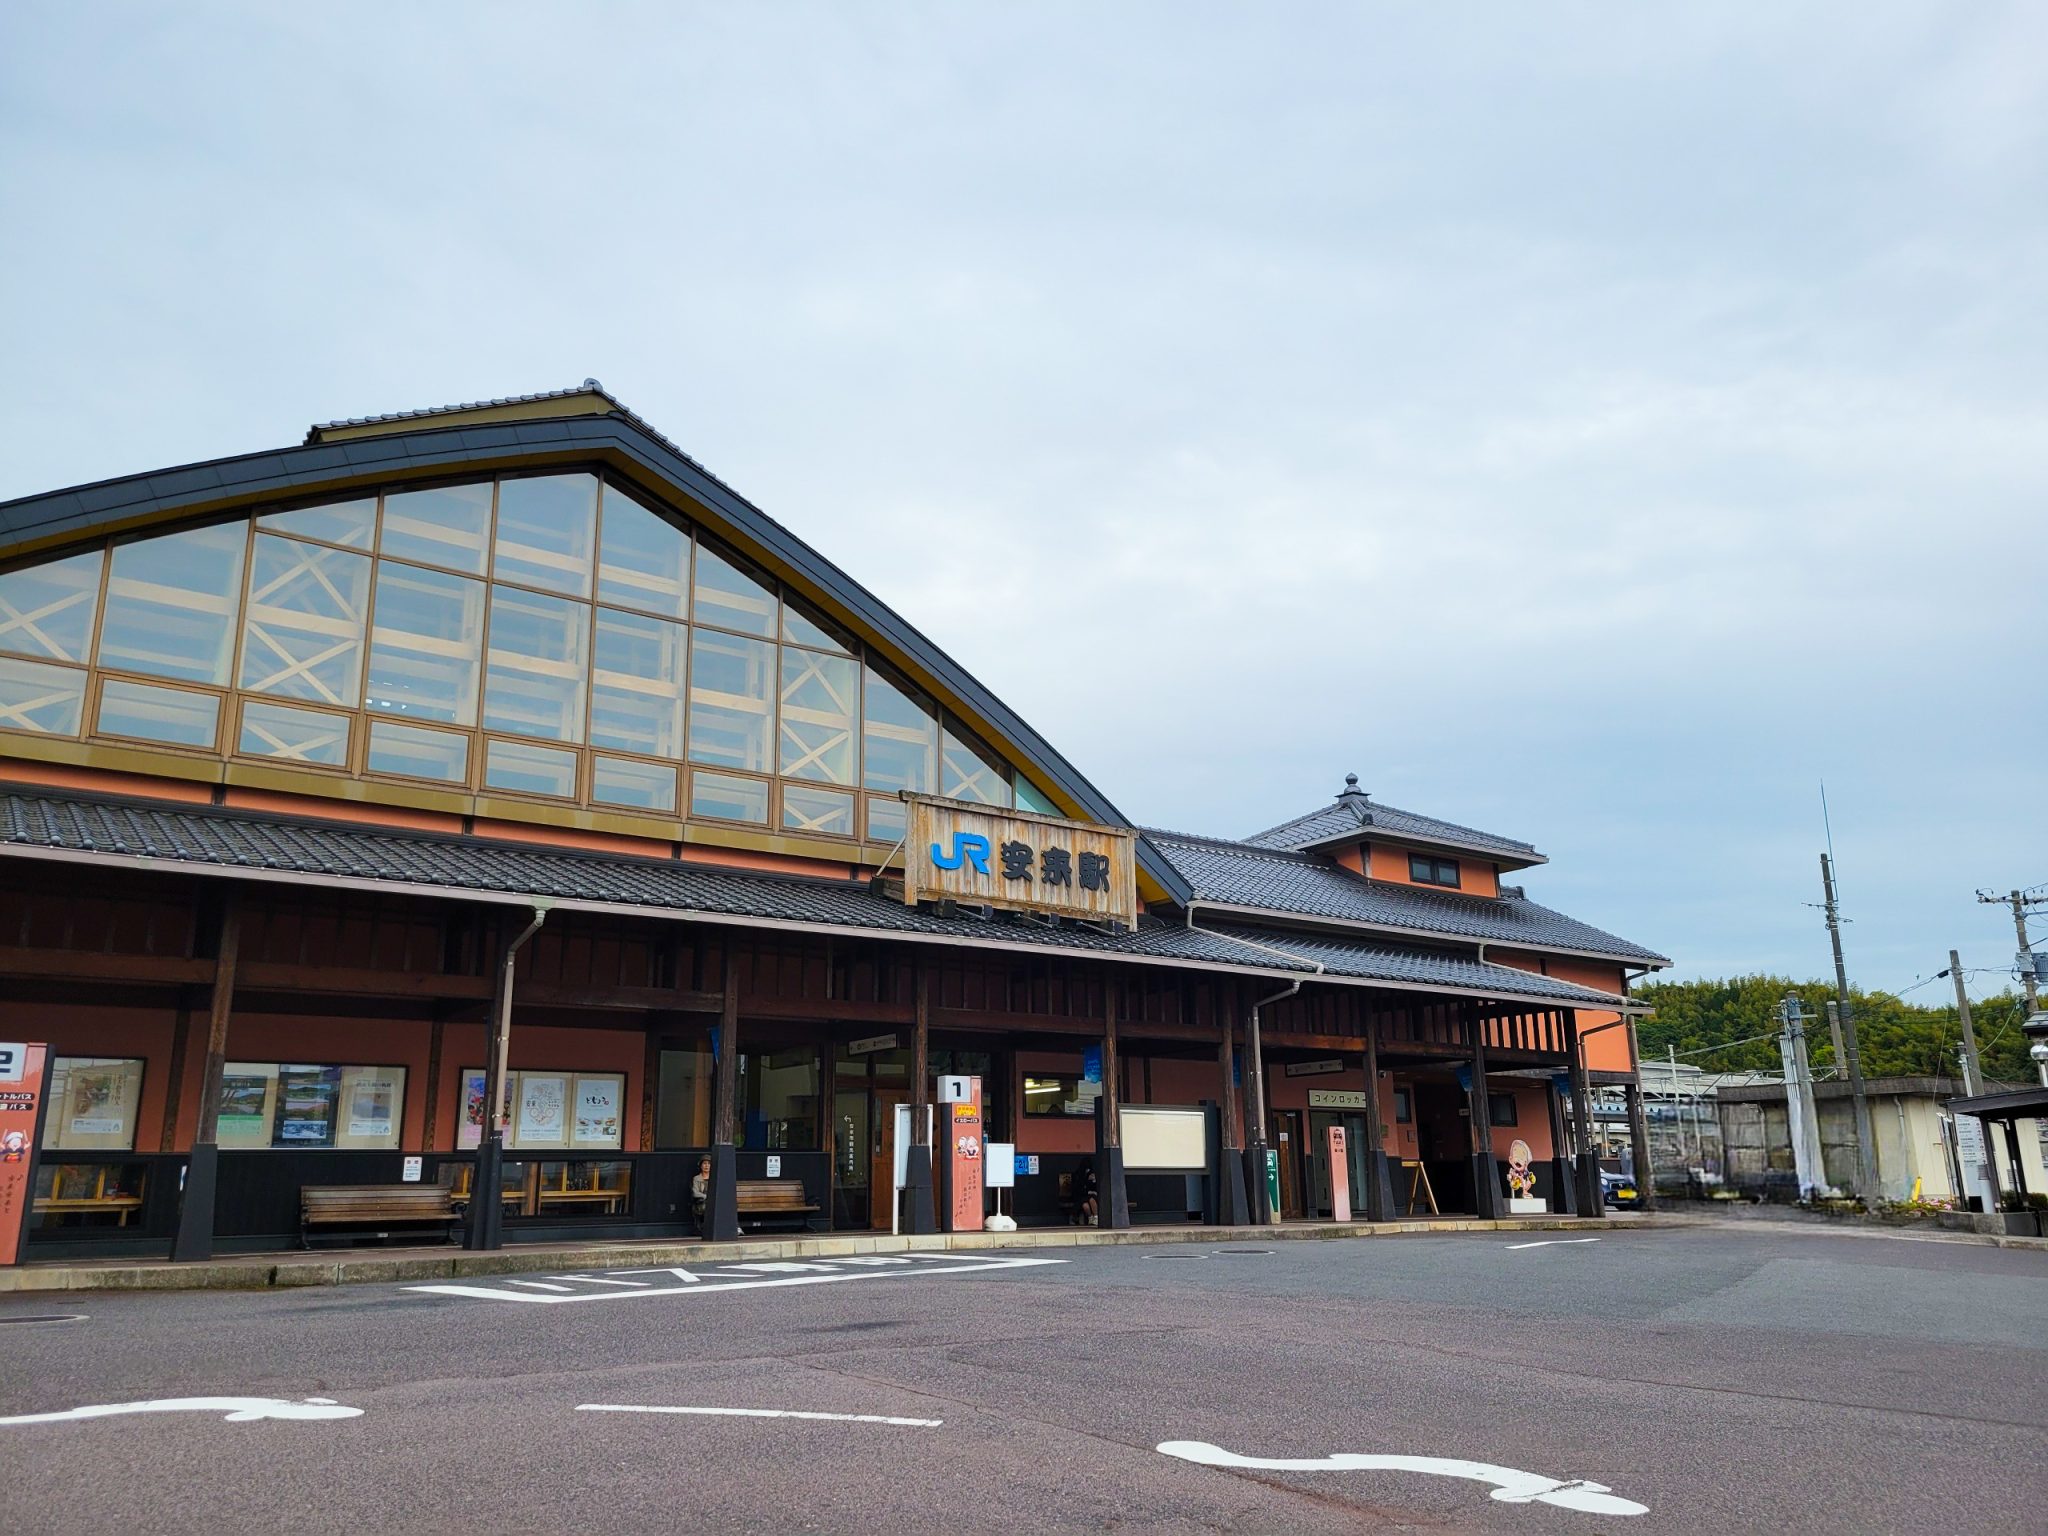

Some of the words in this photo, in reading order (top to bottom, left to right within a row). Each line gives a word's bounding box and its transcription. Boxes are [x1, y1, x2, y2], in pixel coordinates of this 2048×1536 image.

[931, 832, 990, 874] JR
[1001, 840, 1110, 893] 安来駅
[953, 1082, 961, 1097] 1
